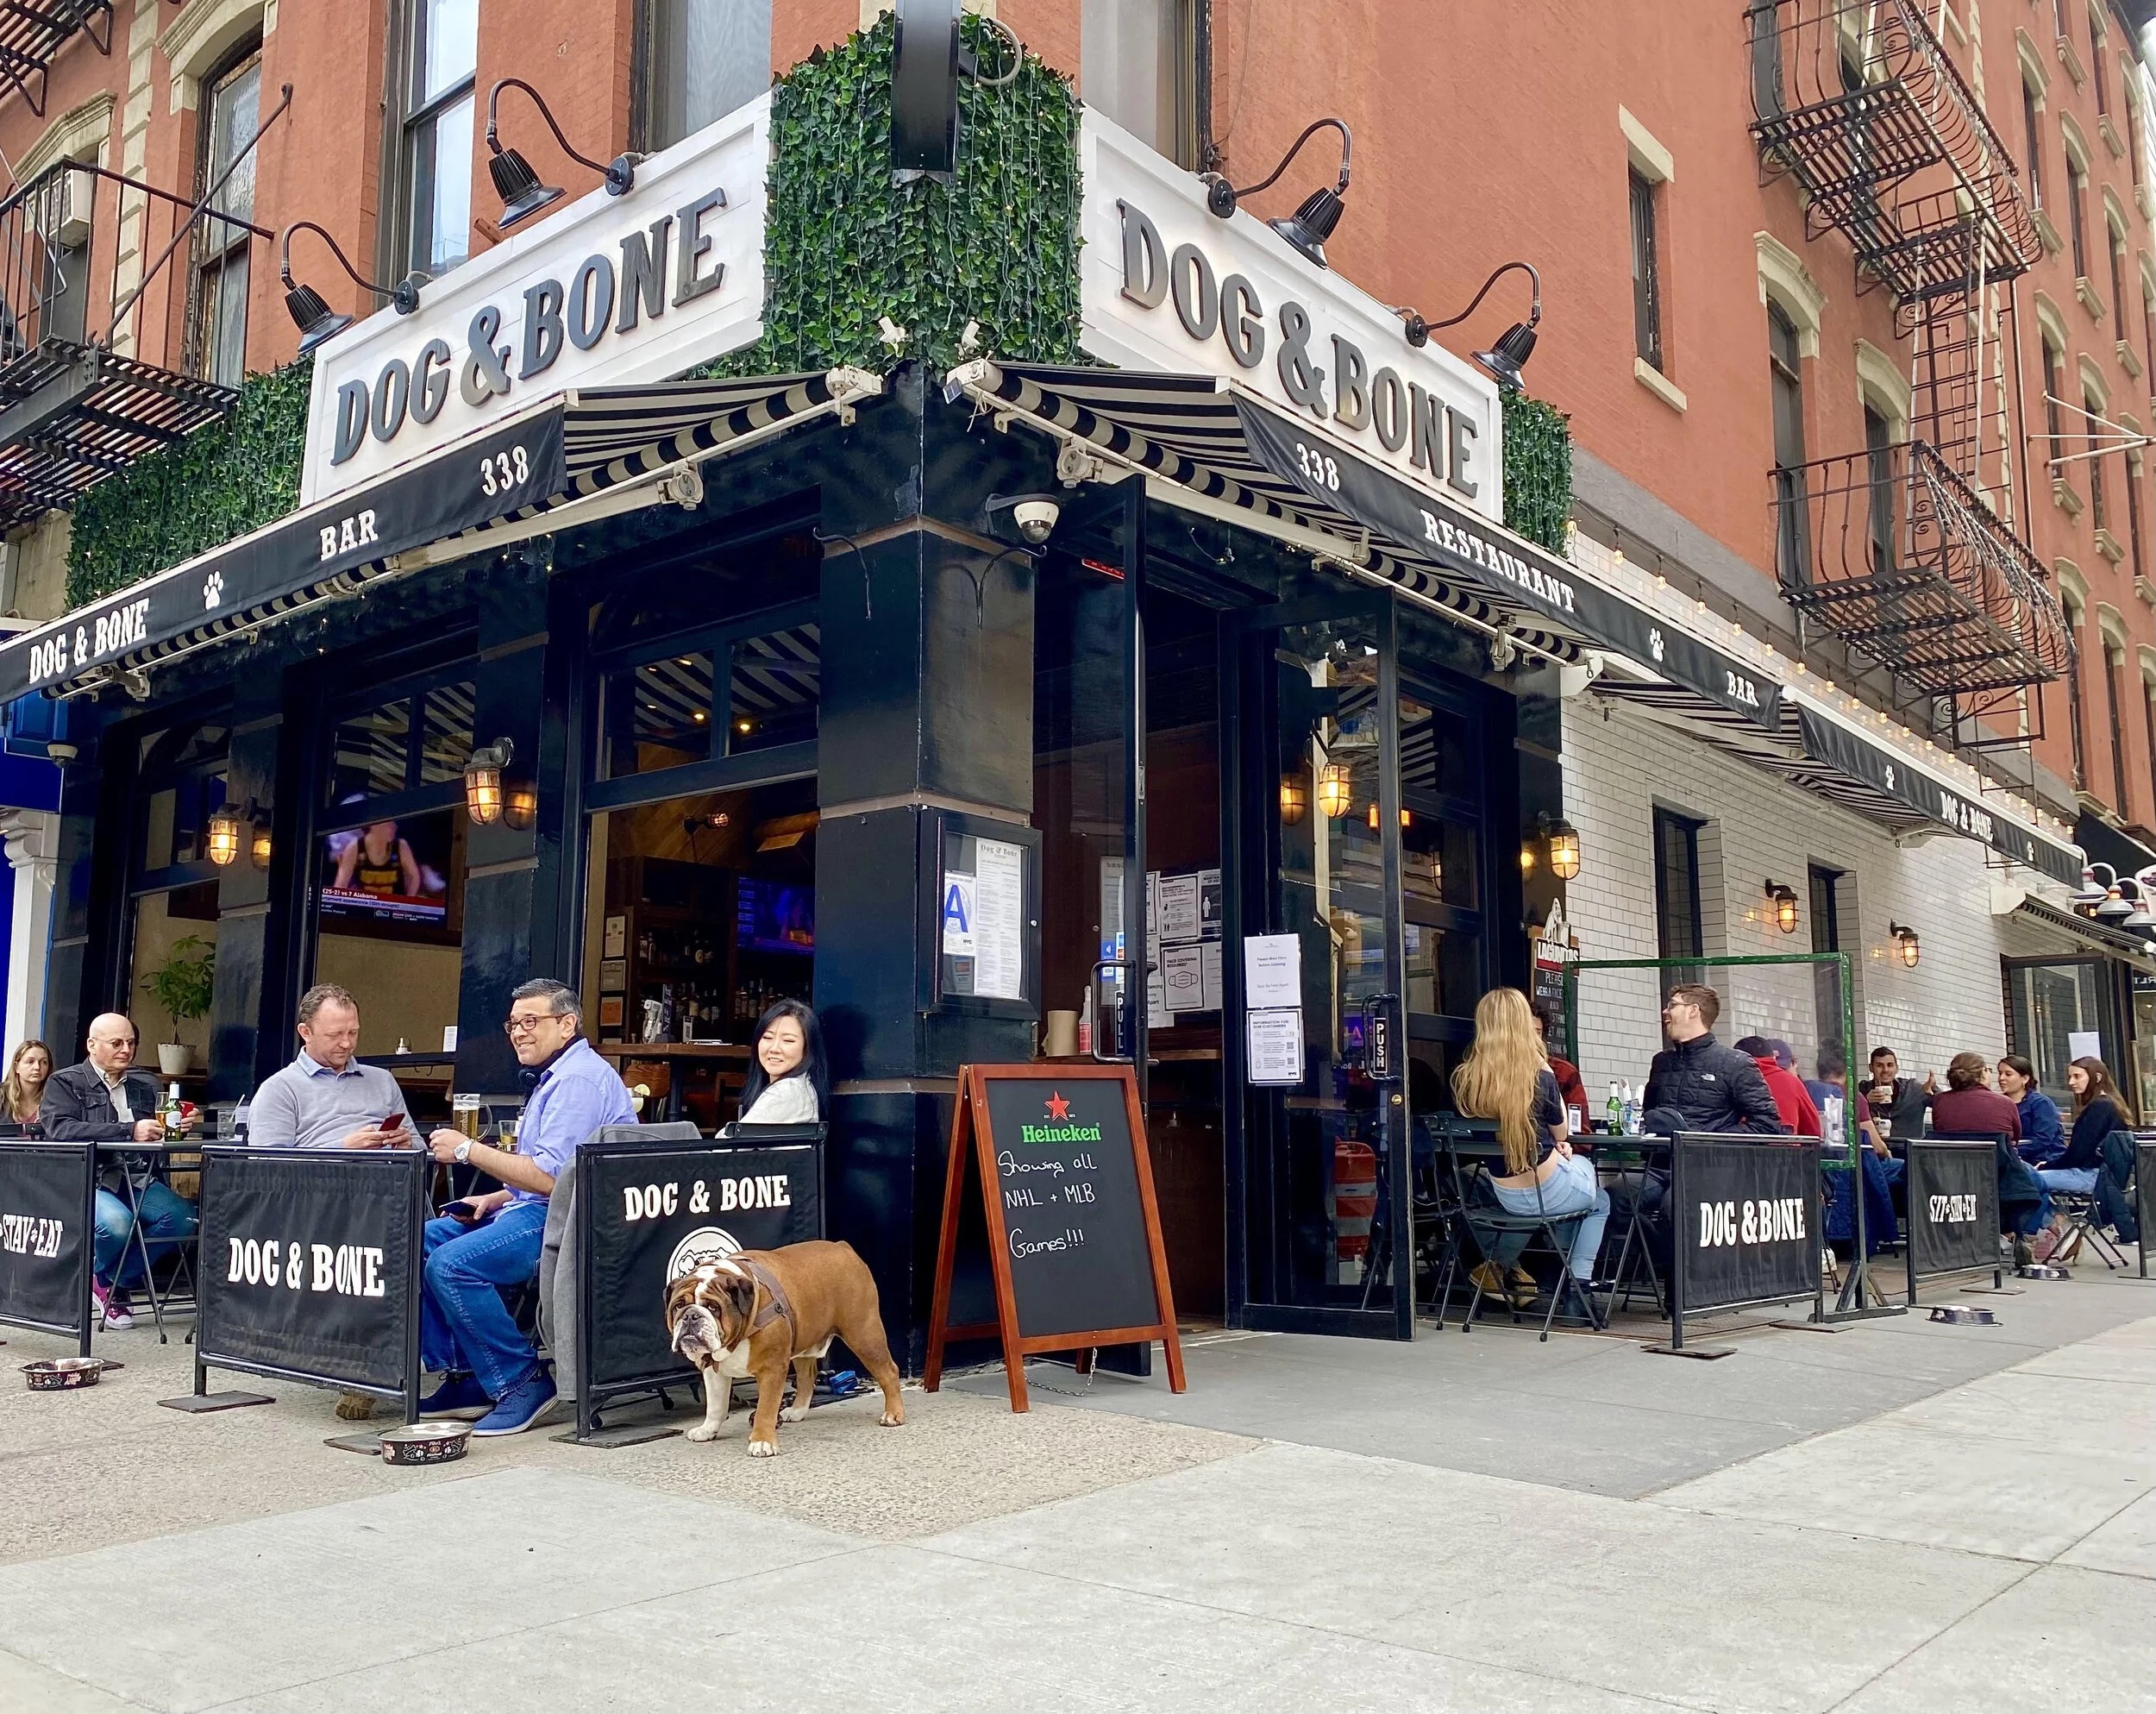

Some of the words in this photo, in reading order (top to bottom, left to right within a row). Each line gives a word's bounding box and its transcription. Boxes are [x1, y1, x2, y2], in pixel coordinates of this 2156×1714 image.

[330, 337, 451, 468] DOG
[460, 305, 511, 407] &
[518, 186, 728, 381] BONE
[1116, 198, 1265, 369] DOG
[1276, 300, 1328, 420] &
[1332, 333, 1479, 499] BONE
[479, 444, 529, 498] 338
[1295, 443, 1340, 493] 338
[319, 509, 379, 562] BAR
[1420, 509, 1576, 613] RESTAURANT
[28, 637, 68, 685] DOG
[74, 626, 89, 667] &
[94, 597, 150, 656] BONE
[1726, 670, 1760, 707] BAR
[1940, 790, 1959, 826] DOG
[1960, 802, 1969, 831] &
[354, 891, 378, 900] Alabama
[943, 884, 968, 933] A
[1376, 1023, 1385, 1068] PUSH
[1021, 1123, 1102, 1144] Heineken
[998, 1150, 1065, 1178] Showing
[1073, 1152, 1098, 1171] all
[624, 1182, 680, 1221] DOG
[689, 1179, 711, 1215] &
[720, 1175, 792, 1212] BONE
[1005, 1188, 1044, 1209] NHL
[1050, 1193, 1058, 1203] +
[1064, 1182, 1095, 1204] MLB
[2, 1214, 33, 1253] STAY
[34, 1218, 64, 1259] EAT
[1009, 1227, 1085, 1259] Games!!!
[1699, 1201, 1738, 1248] DOG
[1758, 1197, 1806, 1242] BONE
[228, 1236, 280, 1287] DOG
[285, 1240, 304, 1289] &
[310, 1243, 385, 1297] BONE
